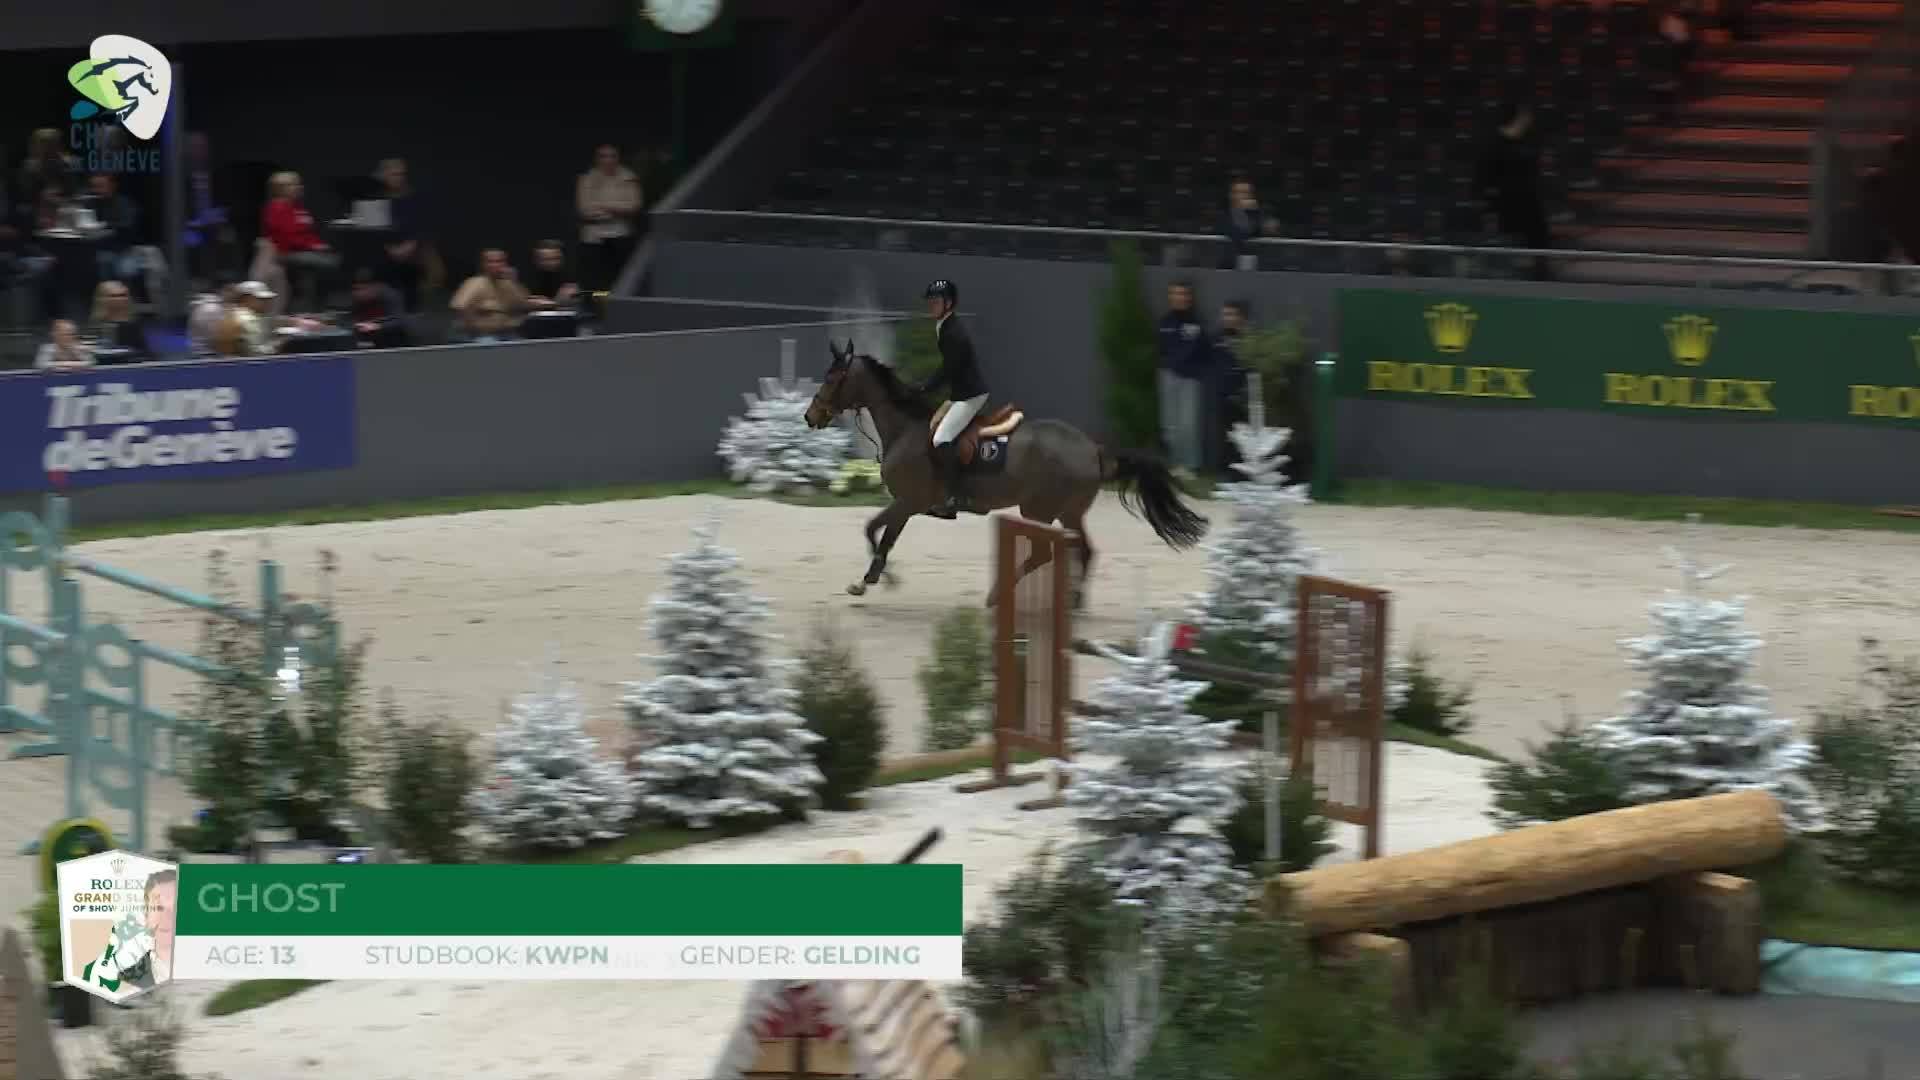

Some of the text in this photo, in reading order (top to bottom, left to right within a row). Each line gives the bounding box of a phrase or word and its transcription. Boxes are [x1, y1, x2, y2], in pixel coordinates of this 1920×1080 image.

[1366, 360, 1536, 399] ROLEX
[1603, 372, 1776, 412] ROLEX
[45, 382, 240, 428] Tribune
